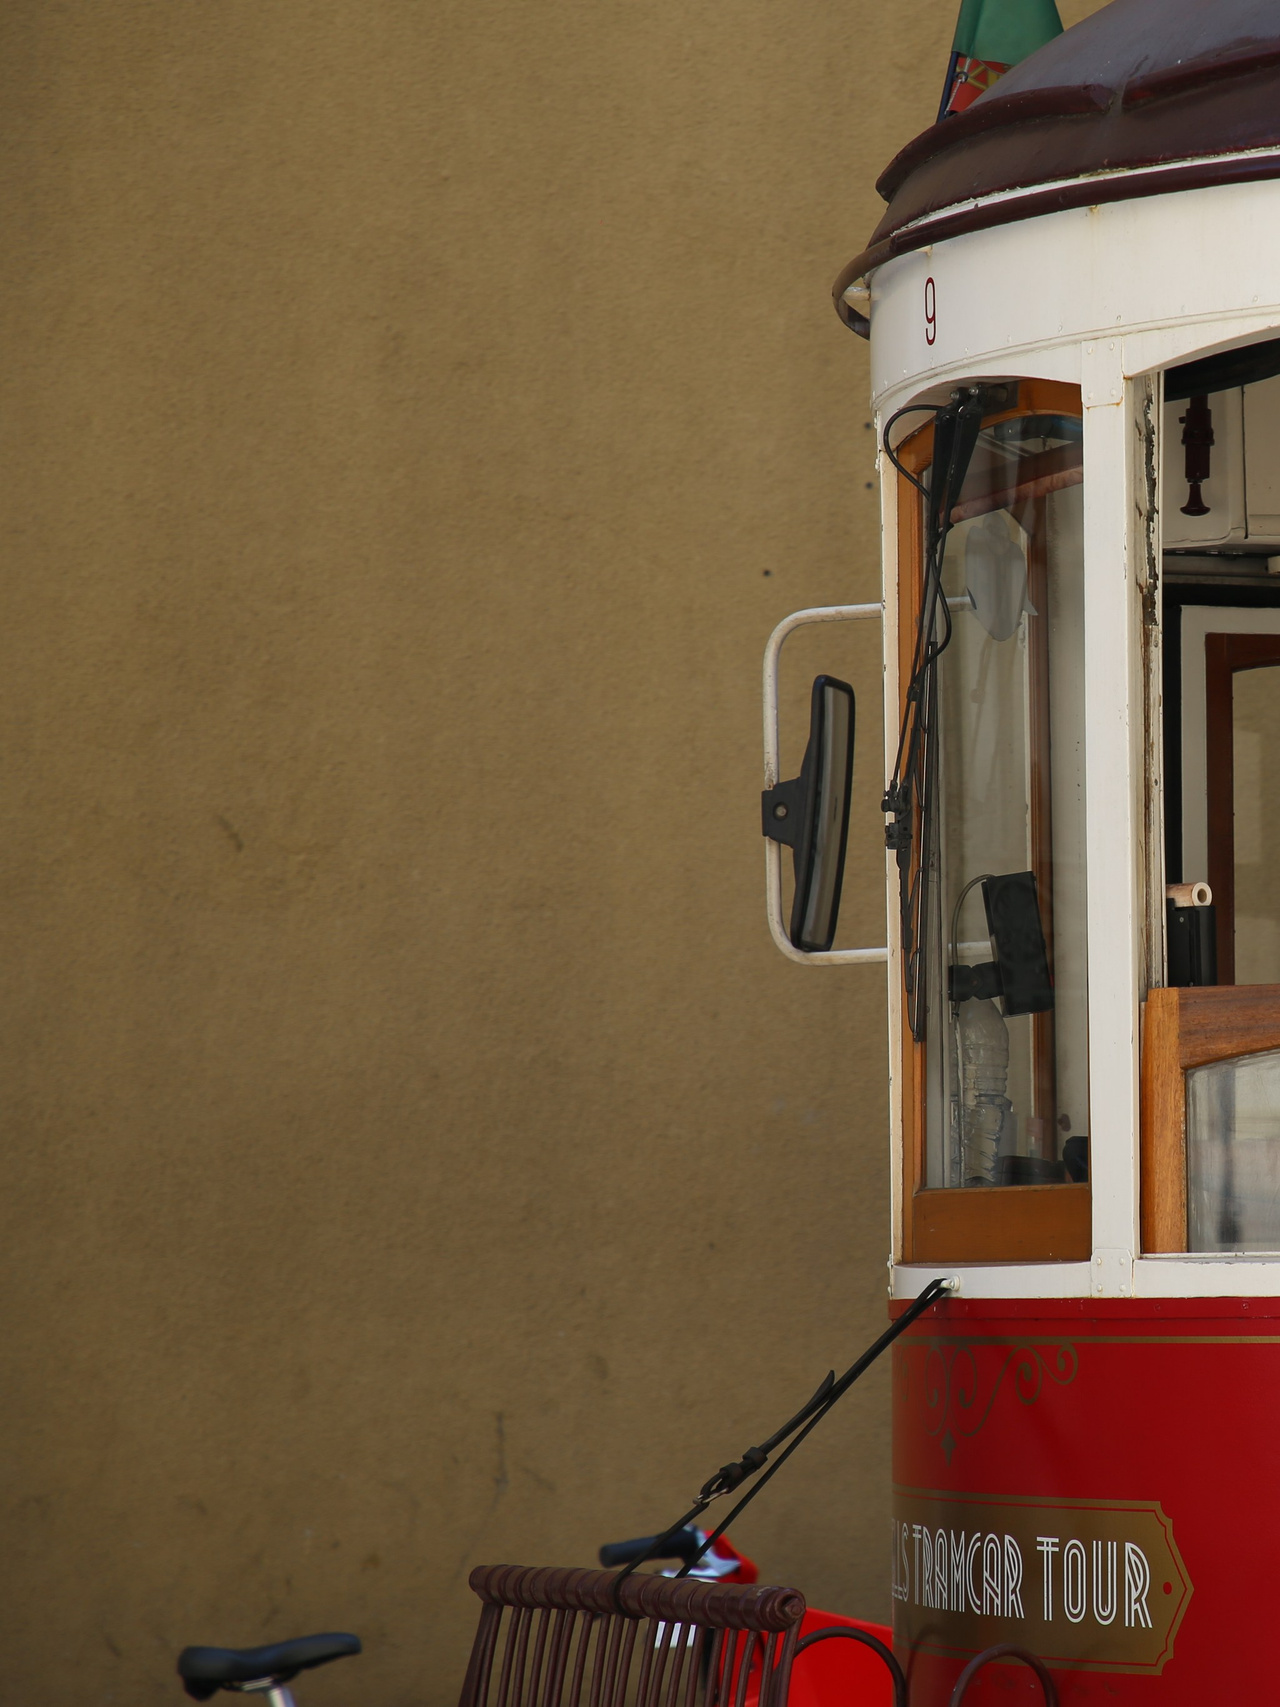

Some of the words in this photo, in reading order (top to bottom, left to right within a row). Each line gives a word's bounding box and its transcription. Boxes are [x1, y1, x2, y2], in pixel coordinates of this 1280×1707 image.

[924, 276, 937, 346] 9
[912, 1524, 1025, 1619] TRAMCAR
[1036, 1536, 1153, 1629] TOUR
